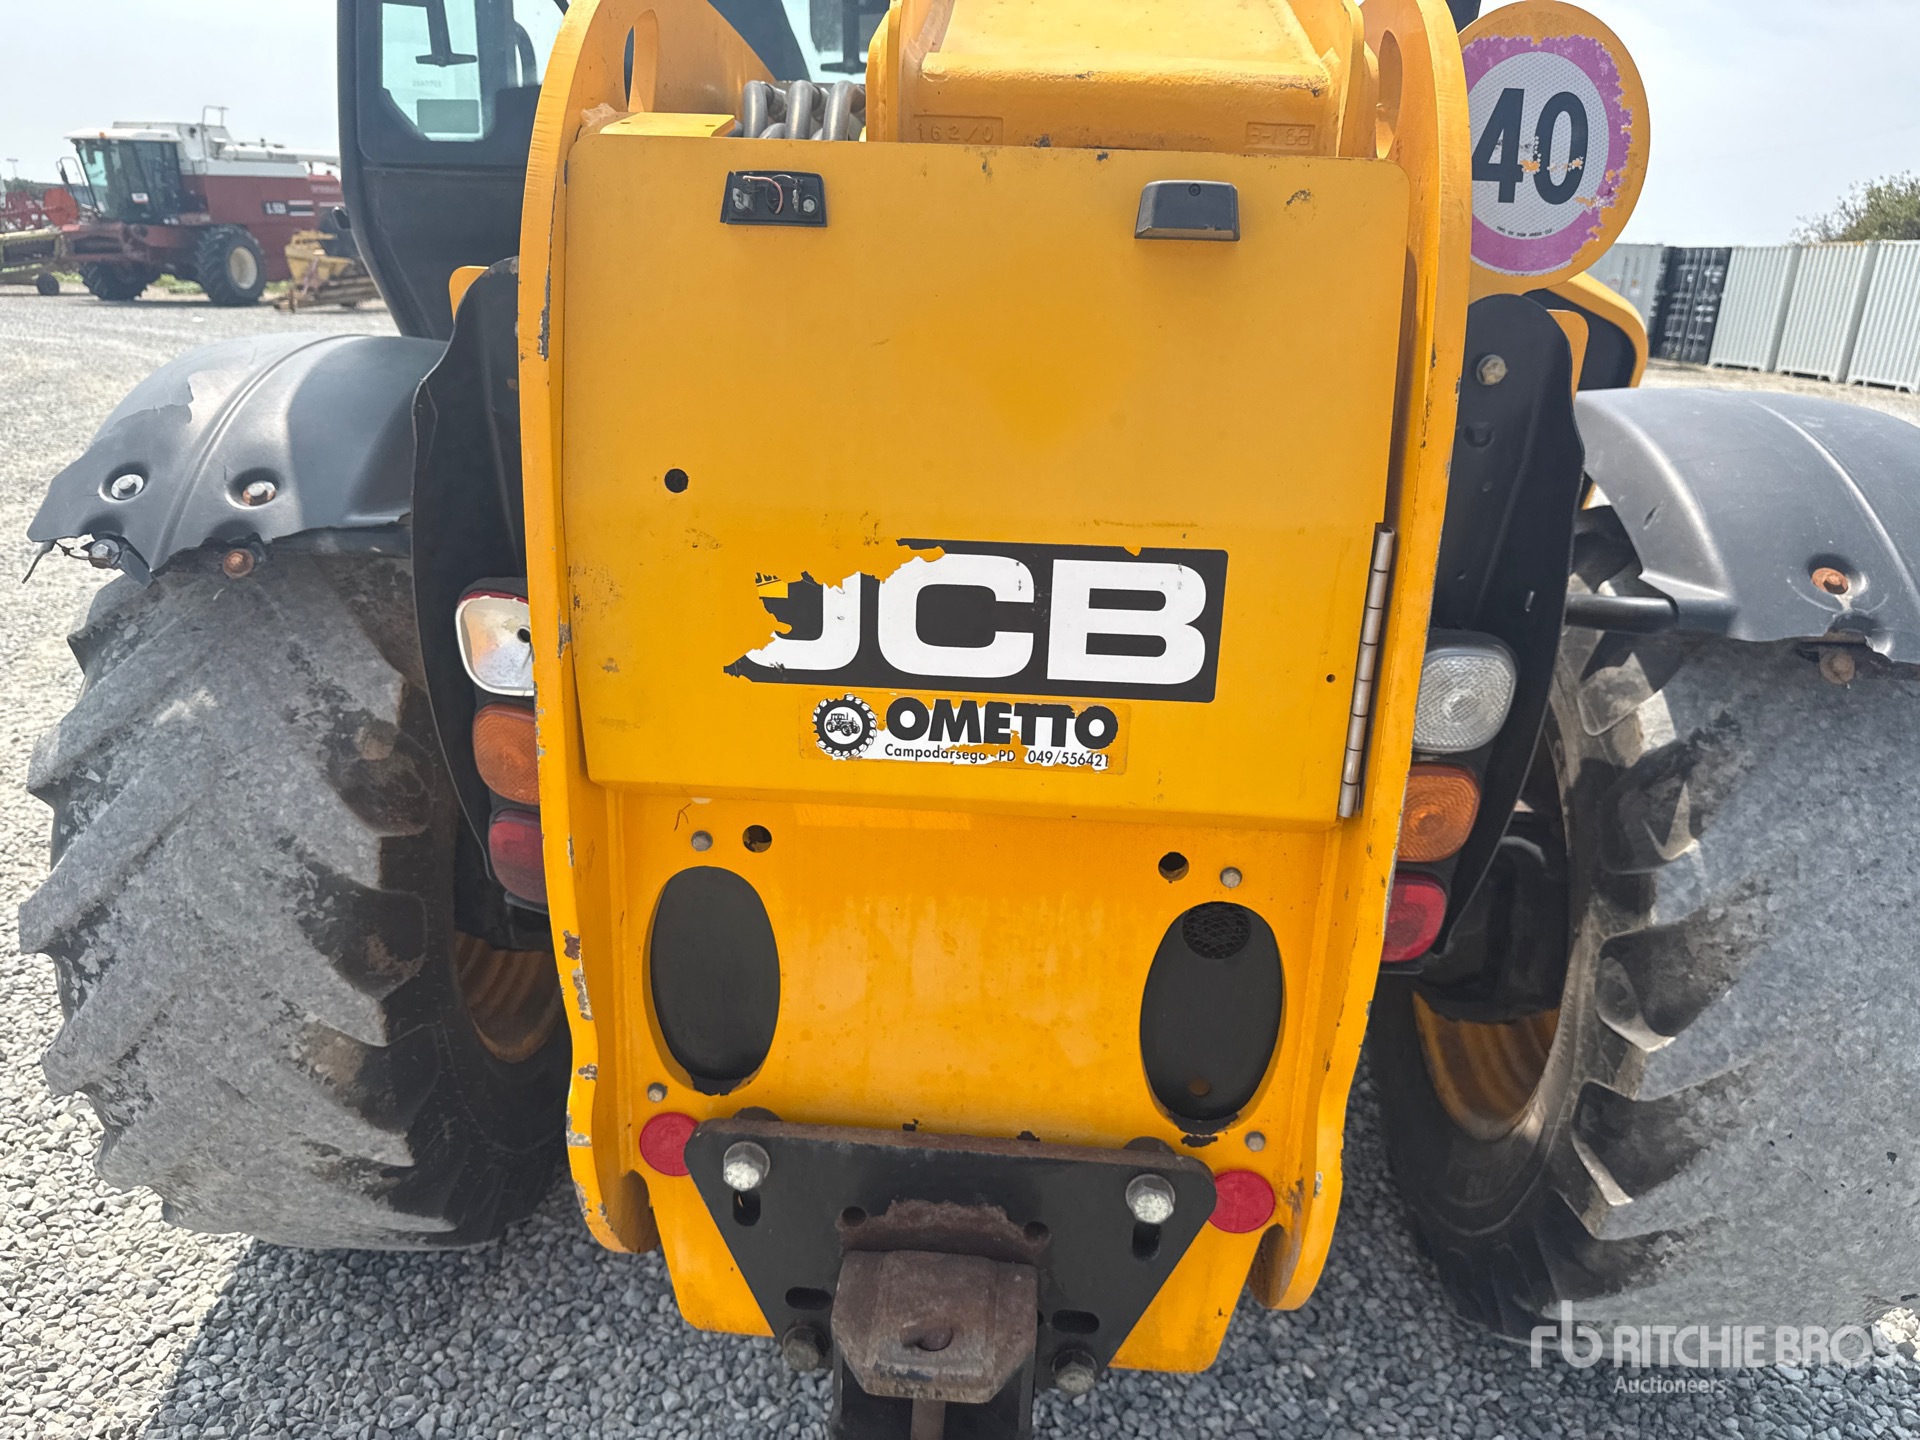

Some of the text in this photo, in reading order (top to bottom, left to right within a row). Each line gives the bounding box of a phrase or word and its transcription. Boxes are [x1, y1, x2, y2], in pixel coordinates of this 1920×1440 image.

[1472, 88, 1588, 205] 40
[746, 553, 1206, 685] JCB
[885, 743, 986, 764] Campodarsego
[998, 749, 1016, 762] PD
[1027, 750, 1109, 767] 049/556421
[886, 697, 1119, 750] OMETTO
